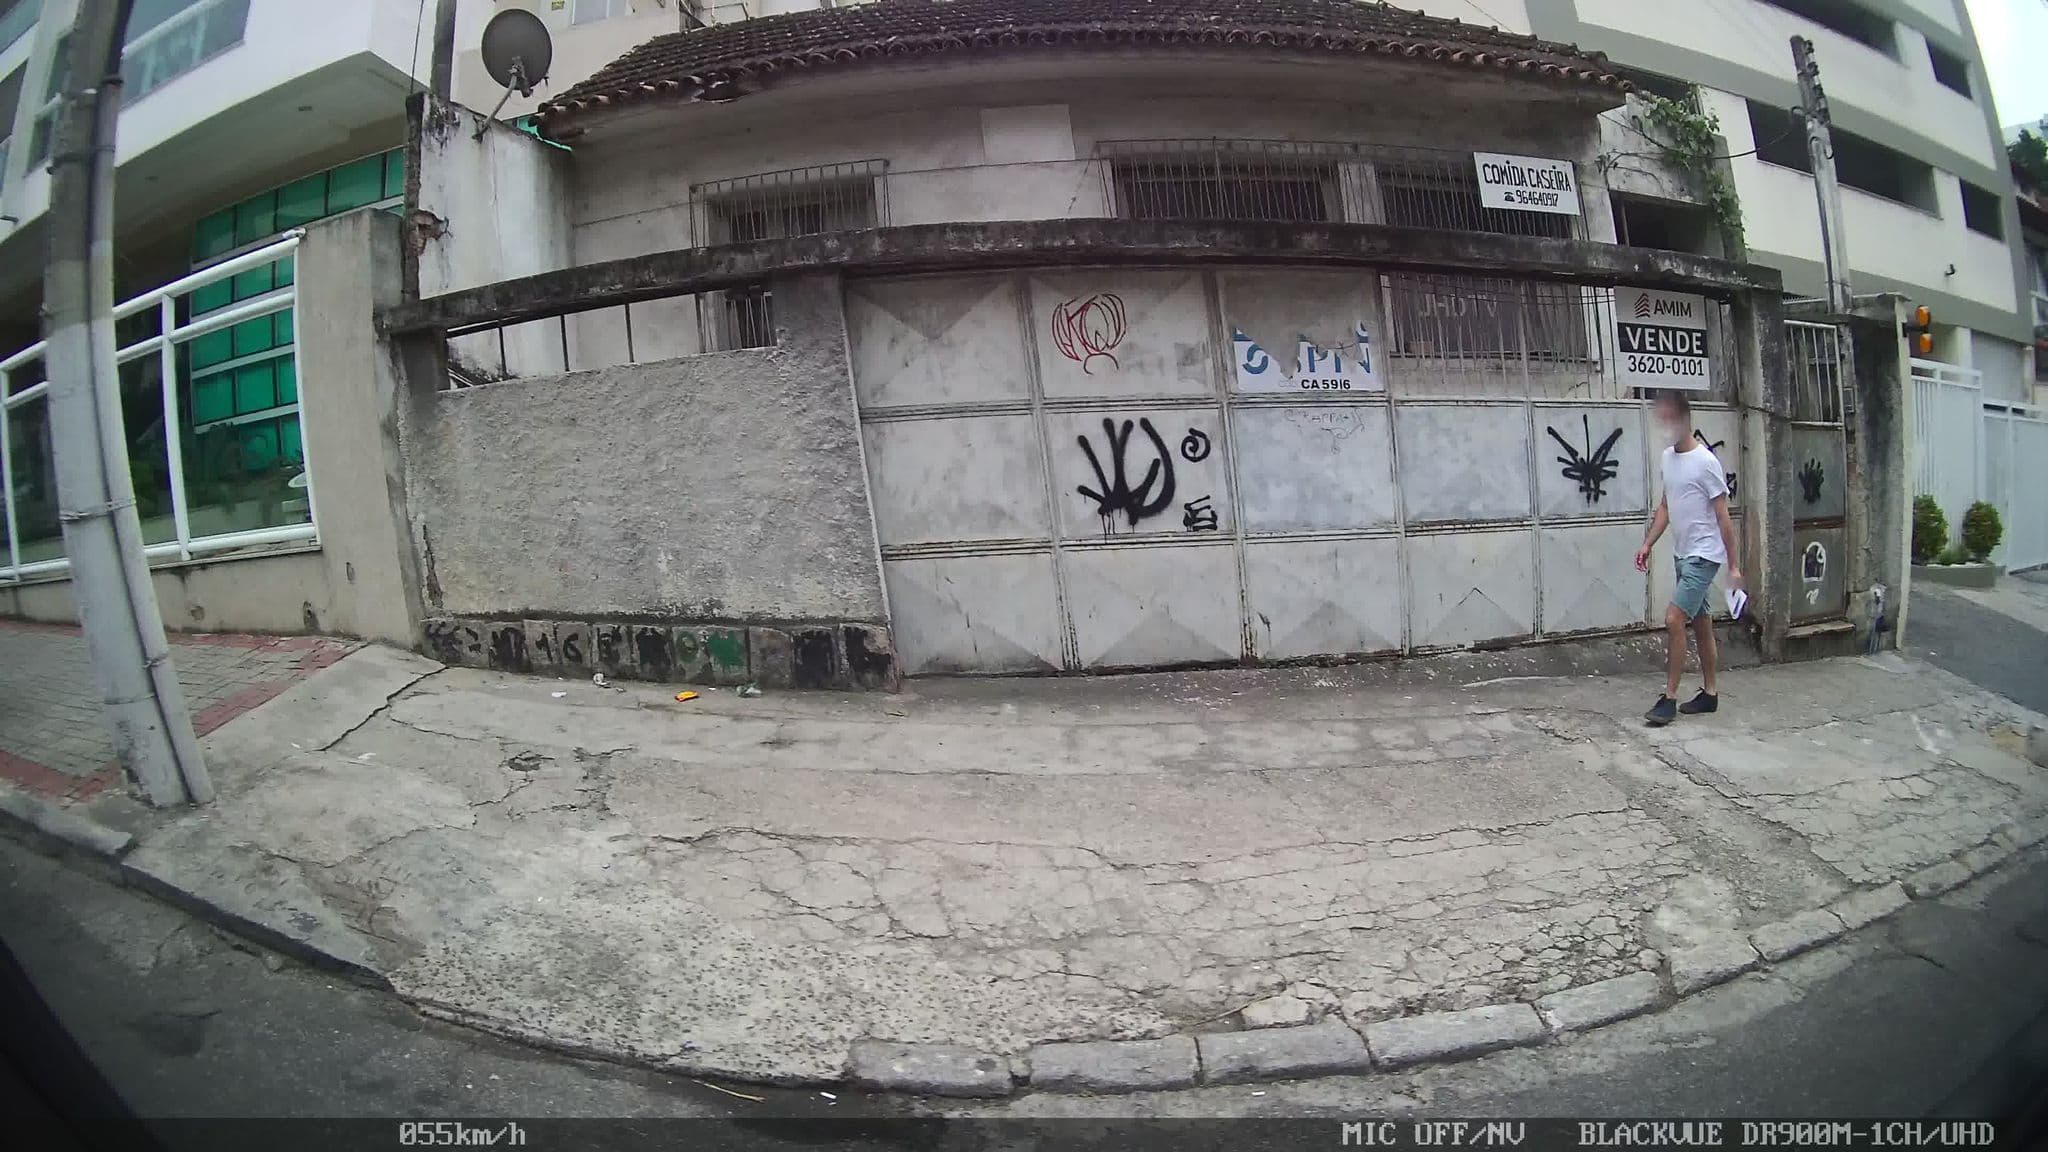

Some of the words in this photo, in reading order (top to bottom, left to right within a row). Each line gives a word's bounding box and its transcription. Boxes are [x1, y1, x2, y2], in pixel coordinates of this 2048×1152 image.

[1653, 299, 1692, 318] AMIM
[1625, 326, 1703, 355] VENDE
[1627, 355, 1704, 377] 3620-0101
